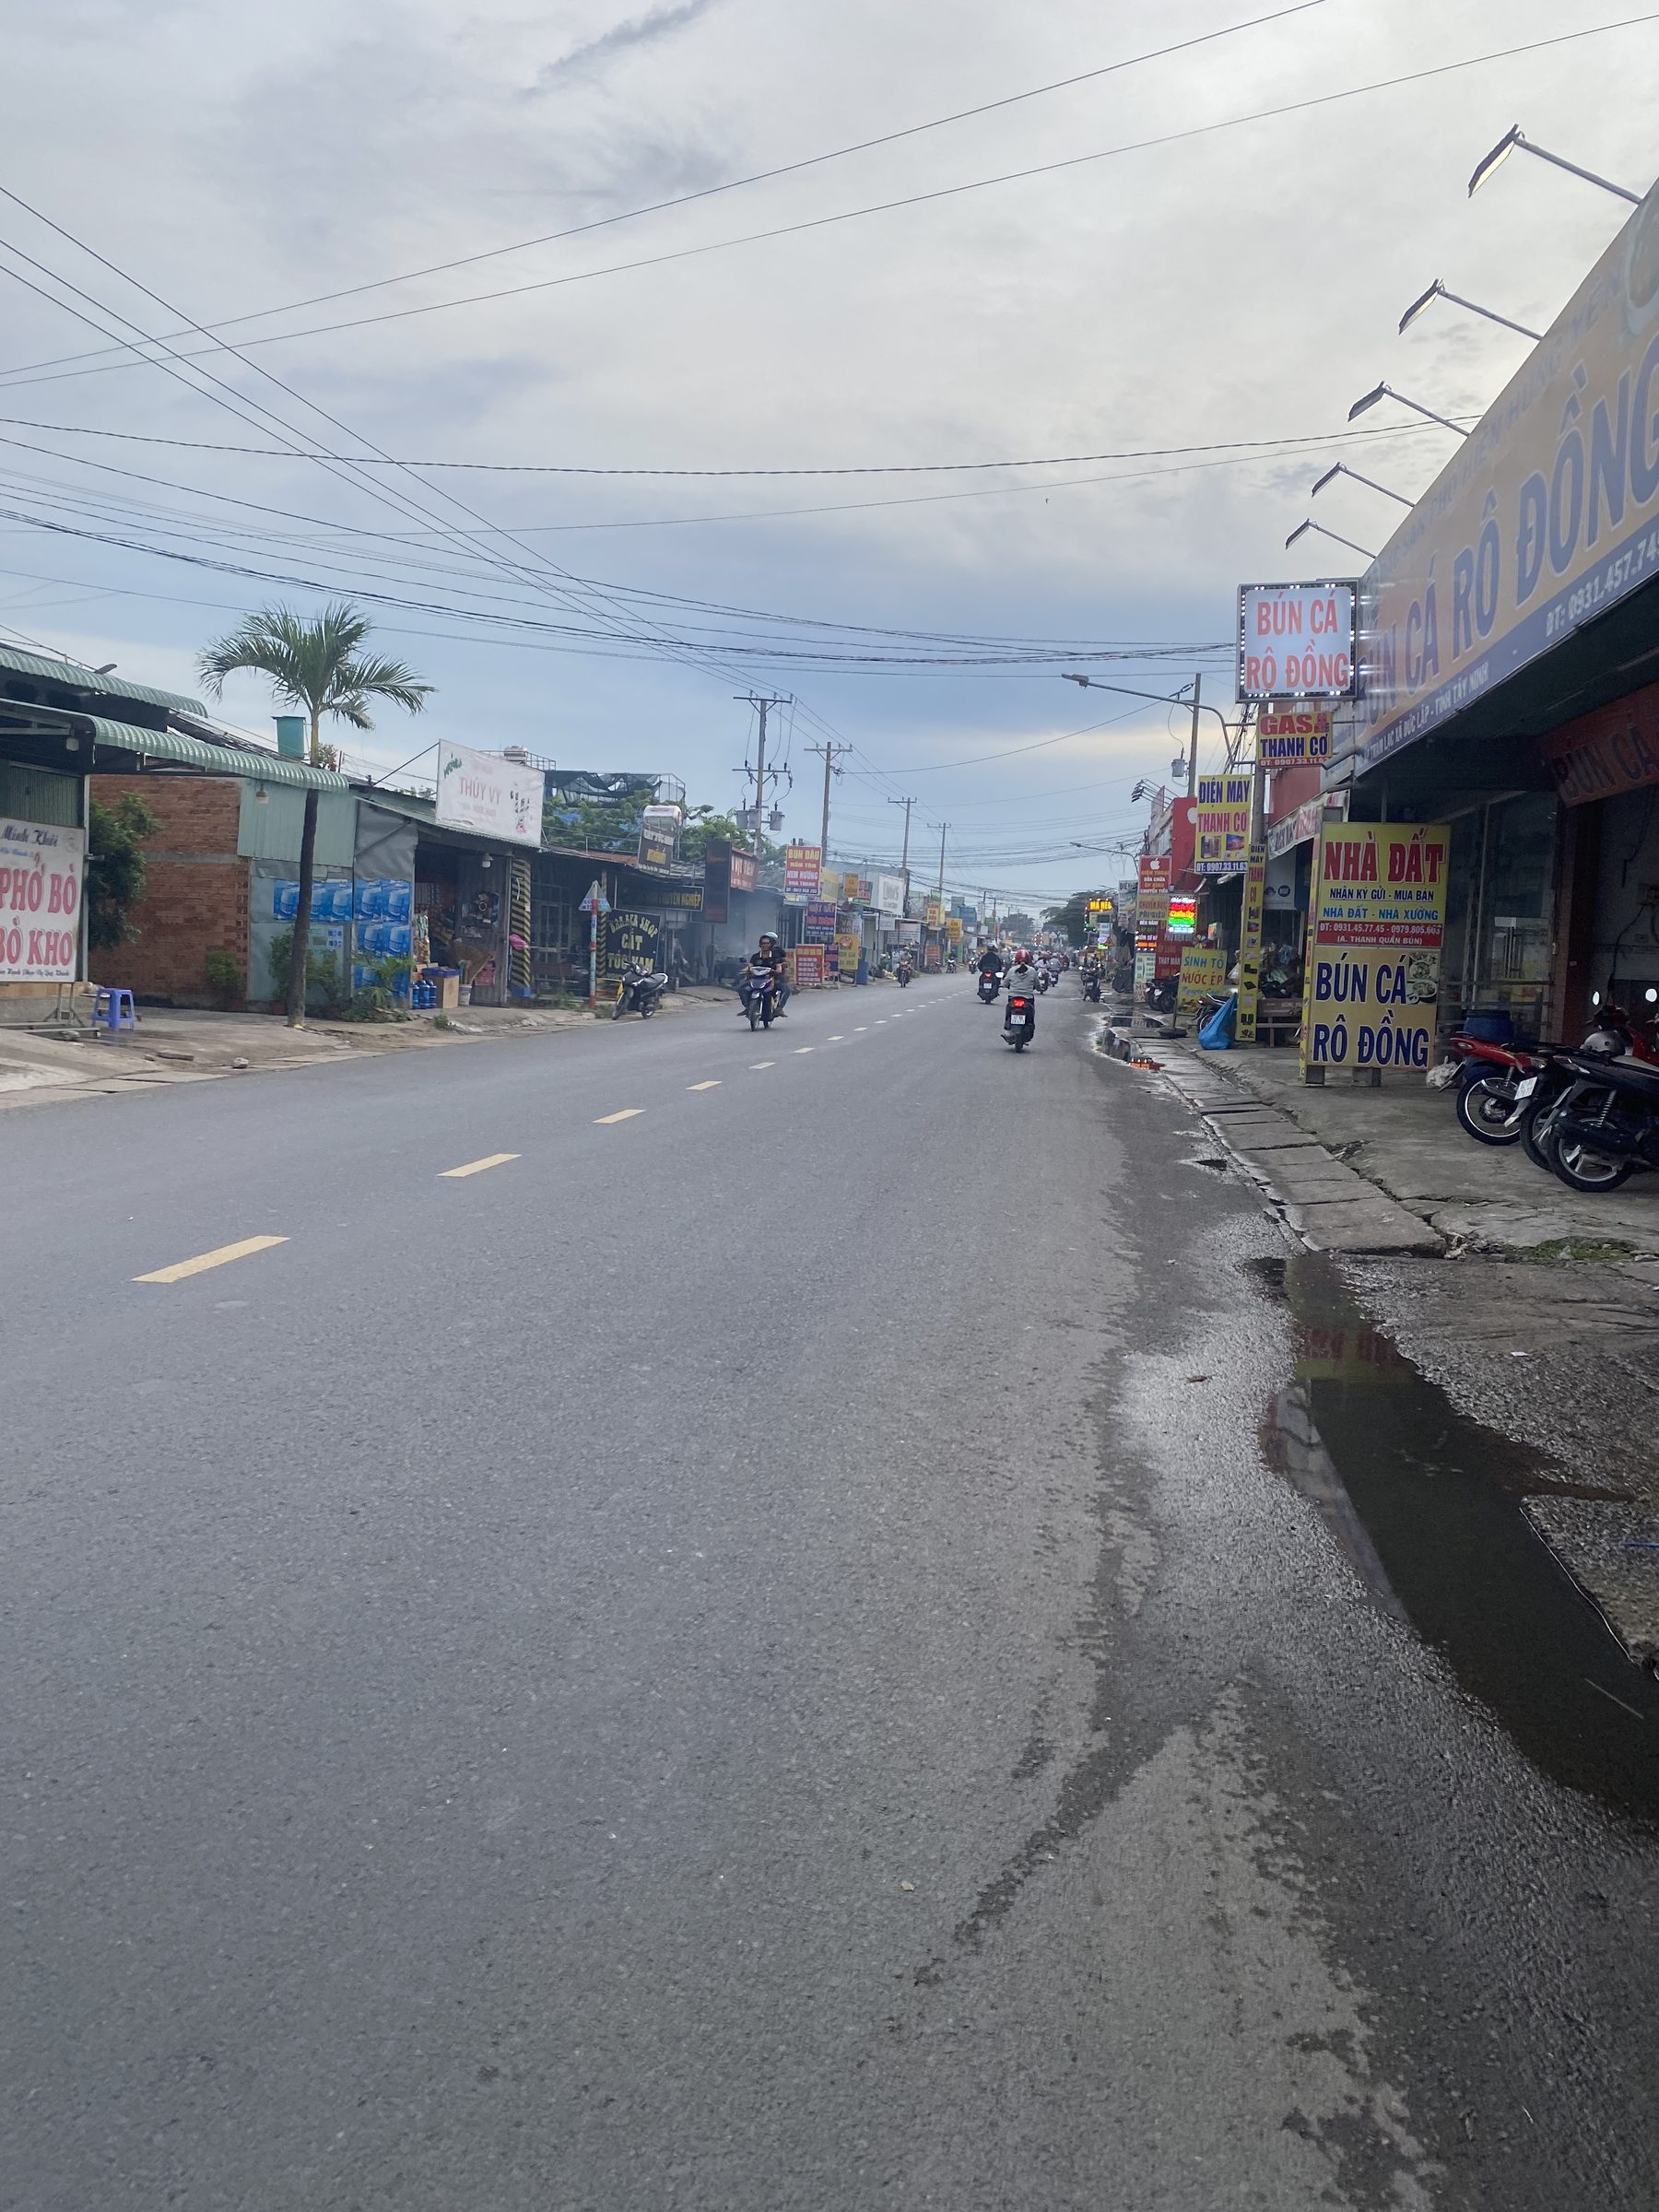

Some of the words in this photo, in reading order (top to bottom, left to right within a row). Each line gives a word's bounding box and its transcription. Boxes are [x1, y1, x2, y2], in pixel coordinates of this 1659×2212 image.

[1405, 549, 1440, 697] CÁ
[1452, 488, 1500, 664] RÔ
[1568, 531, 1659, 620] 0931.457.74
[1257, 591, 1302, 635] BÚN
[1310, 590, 1338, 634] CÁ
[1285, 639, 1348, 688] ĐỒNG
[1260, 714, 1312, 735] GAS
[1260, 736, 1305, 758] THANH
[1199, 777, 1223, 807] ĐIỆN
[1227, 777, 1250, 804] MÁY
[1198, 812, 1230, 832] THANH
[1324, 830, 1379, 883] NHÀ
[1387, 828, 1444, 884] ĐẤT
[48, 863, 77, 915] BÒ
[1330, 886, 1354, 900] NHẬN
[1357, 887, 1369, 900] KÝ
[1371, 886, 1386, 900] GỬI
[1394, 889, 1413, 900] MUA
[1416, 888, 1434, 901] BÁN
[1323, 906, 1344, 918] NHÀ
[1347, 904, 1369, 918] ĐẤT
[1379, 907, 1399, 920] NHÀ
[1404, 906, 1439, 921] XƯỞNG
[1334, 923, 1385, 934] 0931.45.77.45
[27, 929, 73, 967] KHO
[1350, 935, 1377, 944] THANH
[1183, 956, 1207, 968] SINH
[1315, 952, 1369, 1003] BÚN
[1375, 954, 1407, 1005] CÁ
[1312, 1014, 1348, 1064] RÔ
[1357, 1009, 1430, 1069] ĐỒNG
